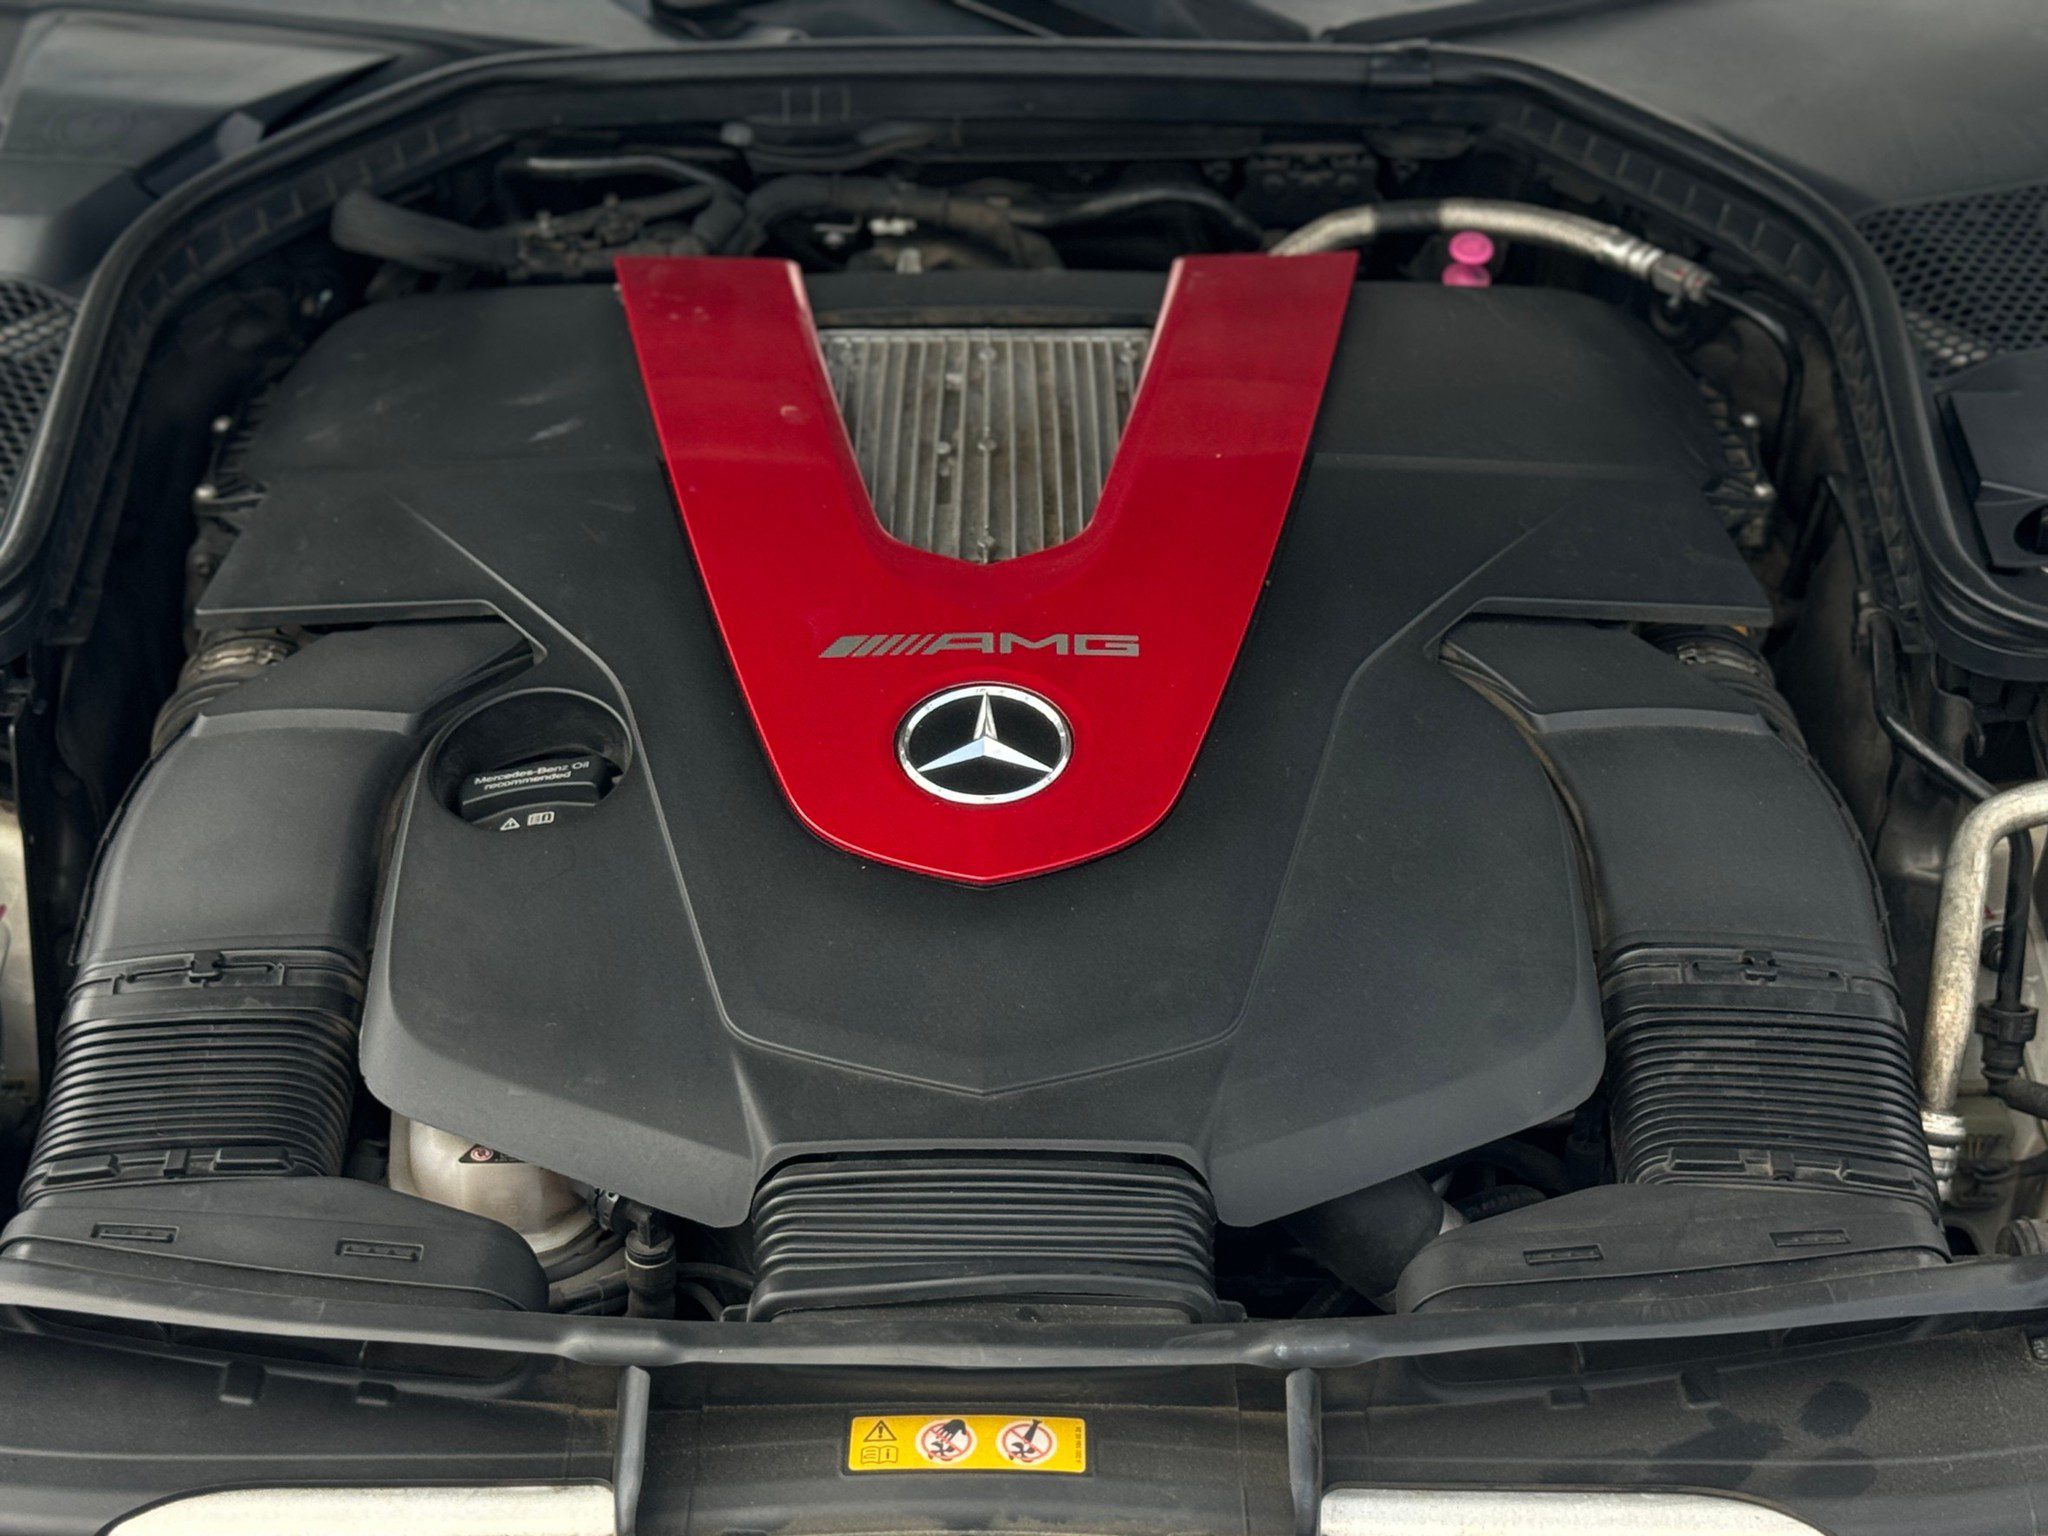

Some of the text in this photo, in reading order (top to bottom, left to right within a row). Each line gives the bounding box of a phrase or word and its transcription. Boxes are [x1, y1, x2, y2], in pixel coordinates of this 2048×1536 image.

[922, 632, 1139, 657] AMG
[474, 761, 590, 785] Mercedes-Benz Oil
[484, 771, 571, 790] recommended
